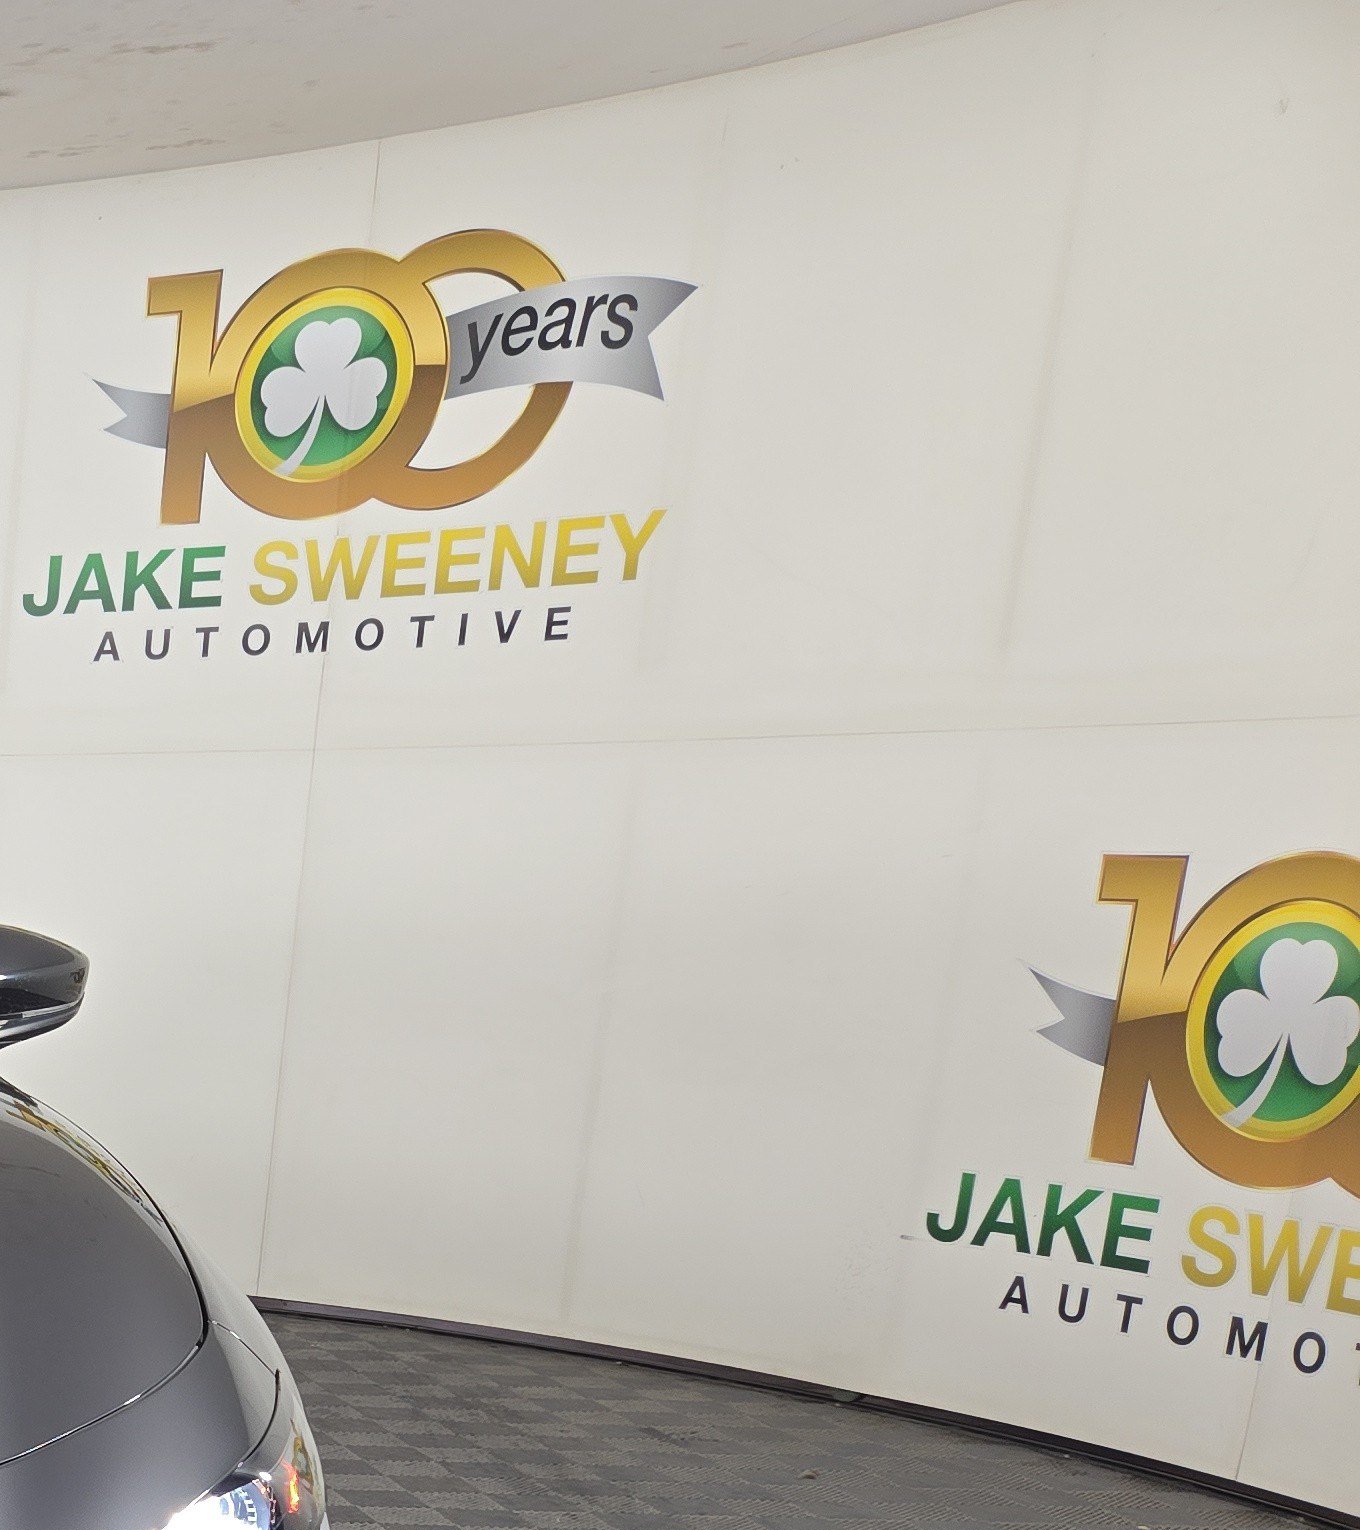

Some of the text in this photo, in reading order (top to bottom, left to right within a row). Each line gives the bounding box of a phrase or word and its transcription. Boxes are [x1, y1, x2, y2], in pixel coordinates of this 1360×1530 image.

[460, 293, 637, 384] years
[22, 509, 667, 616] JAKE SWEENEY
[93, 606, 572, 662] AUTOMOTIVE
[1090, 851, 1360, 1199] 10
[926, 1172, 1160, 1275] JAKE
[999, 1276, 1360, 1387] AUTOMO
